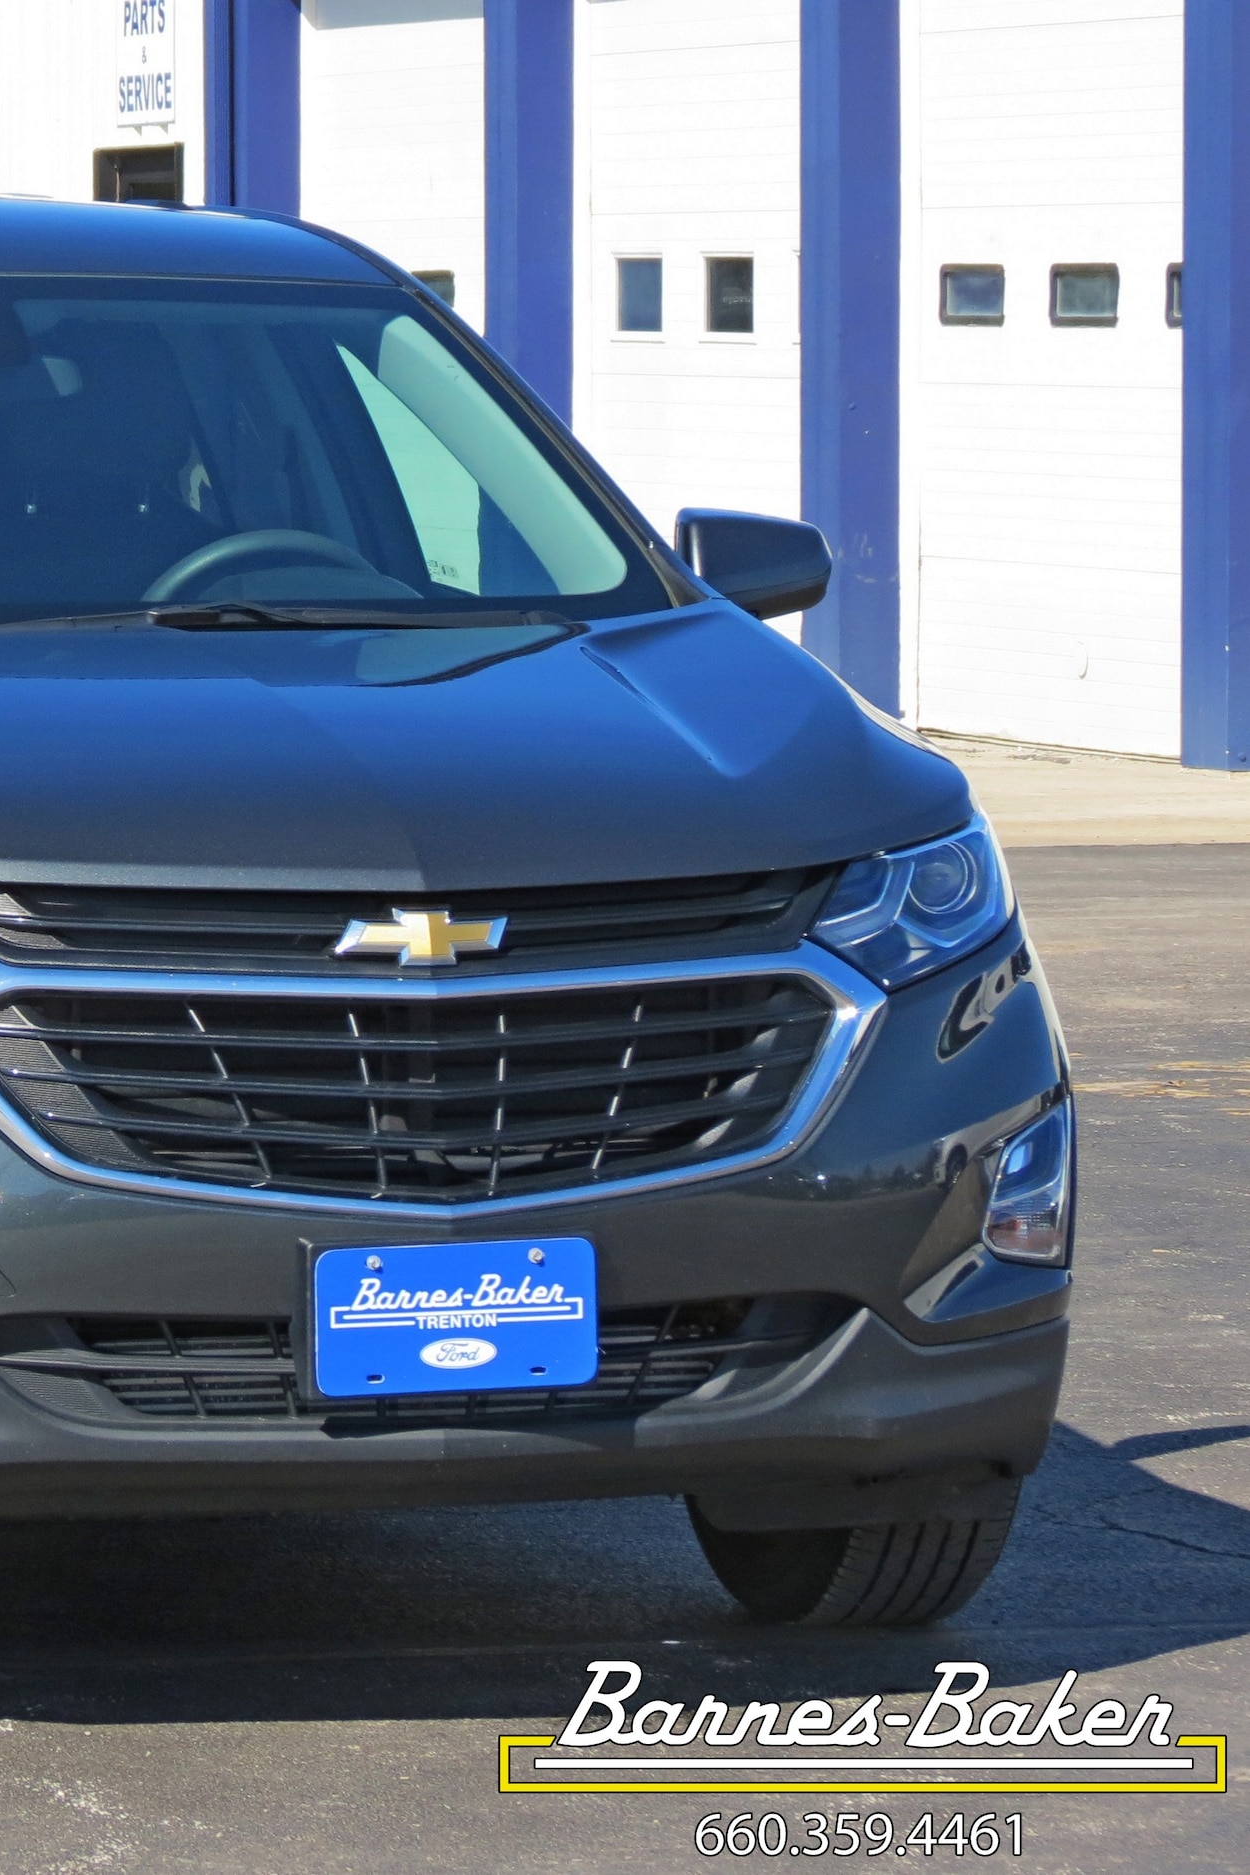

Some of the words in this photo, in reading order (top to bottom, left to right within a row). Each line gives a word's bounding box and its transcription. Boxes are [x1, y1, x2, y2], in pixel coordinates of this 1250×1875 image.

[123, 0, 166, 37] PARTS
[118, 72, 173, 113] SERVICE
[350, 1273, 565, 1312] Barnes-Baker
[416, 1314, 498, 1329] TRENTON
[436, 1342, 480, 1363] Ford
